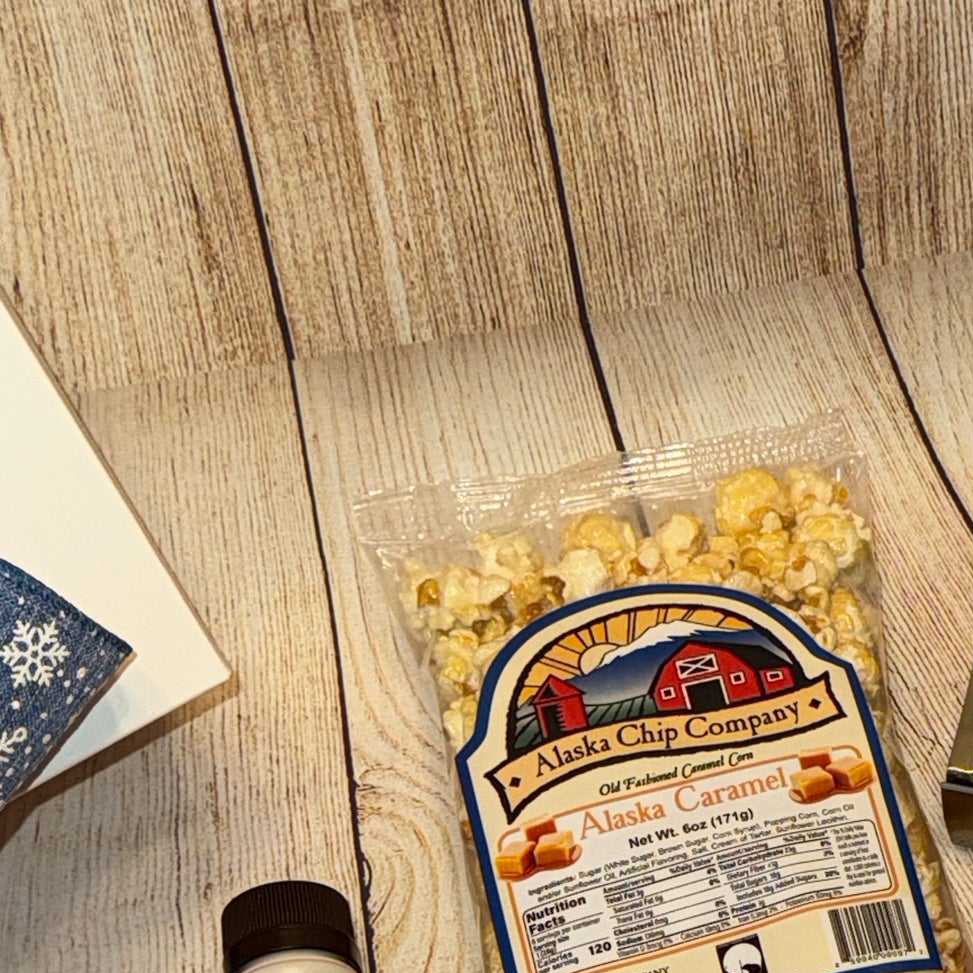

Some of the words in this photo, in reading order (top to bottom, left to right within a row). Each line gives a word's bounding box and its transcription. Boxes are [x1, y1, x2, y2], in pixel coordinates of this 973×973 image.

[536, 735, 612, 777] Alaska
[616, 722, 679, 748] Chip
[685, 699, 799, 738] Company
[599, 778, 621, 796] Old
[623, 766, 678, 790] Fashioned
[681, 755, 724, 778] Caramel
[728, 751, 754, 767] Corn
[580, 801, 667, 840] Alaska
[674, 766, 789, 812] Caramel
[627, 832, 653, 849] Net
[655, 826, 679, 841] Wt.
[682, 819, 707, 834] 6oz
[709, 806, 754, 829] (171g)
[524, 894, 587, 923] Nutrition
[527, 913, 566, 934] Facts
[587, 940, 612, 956] 120
